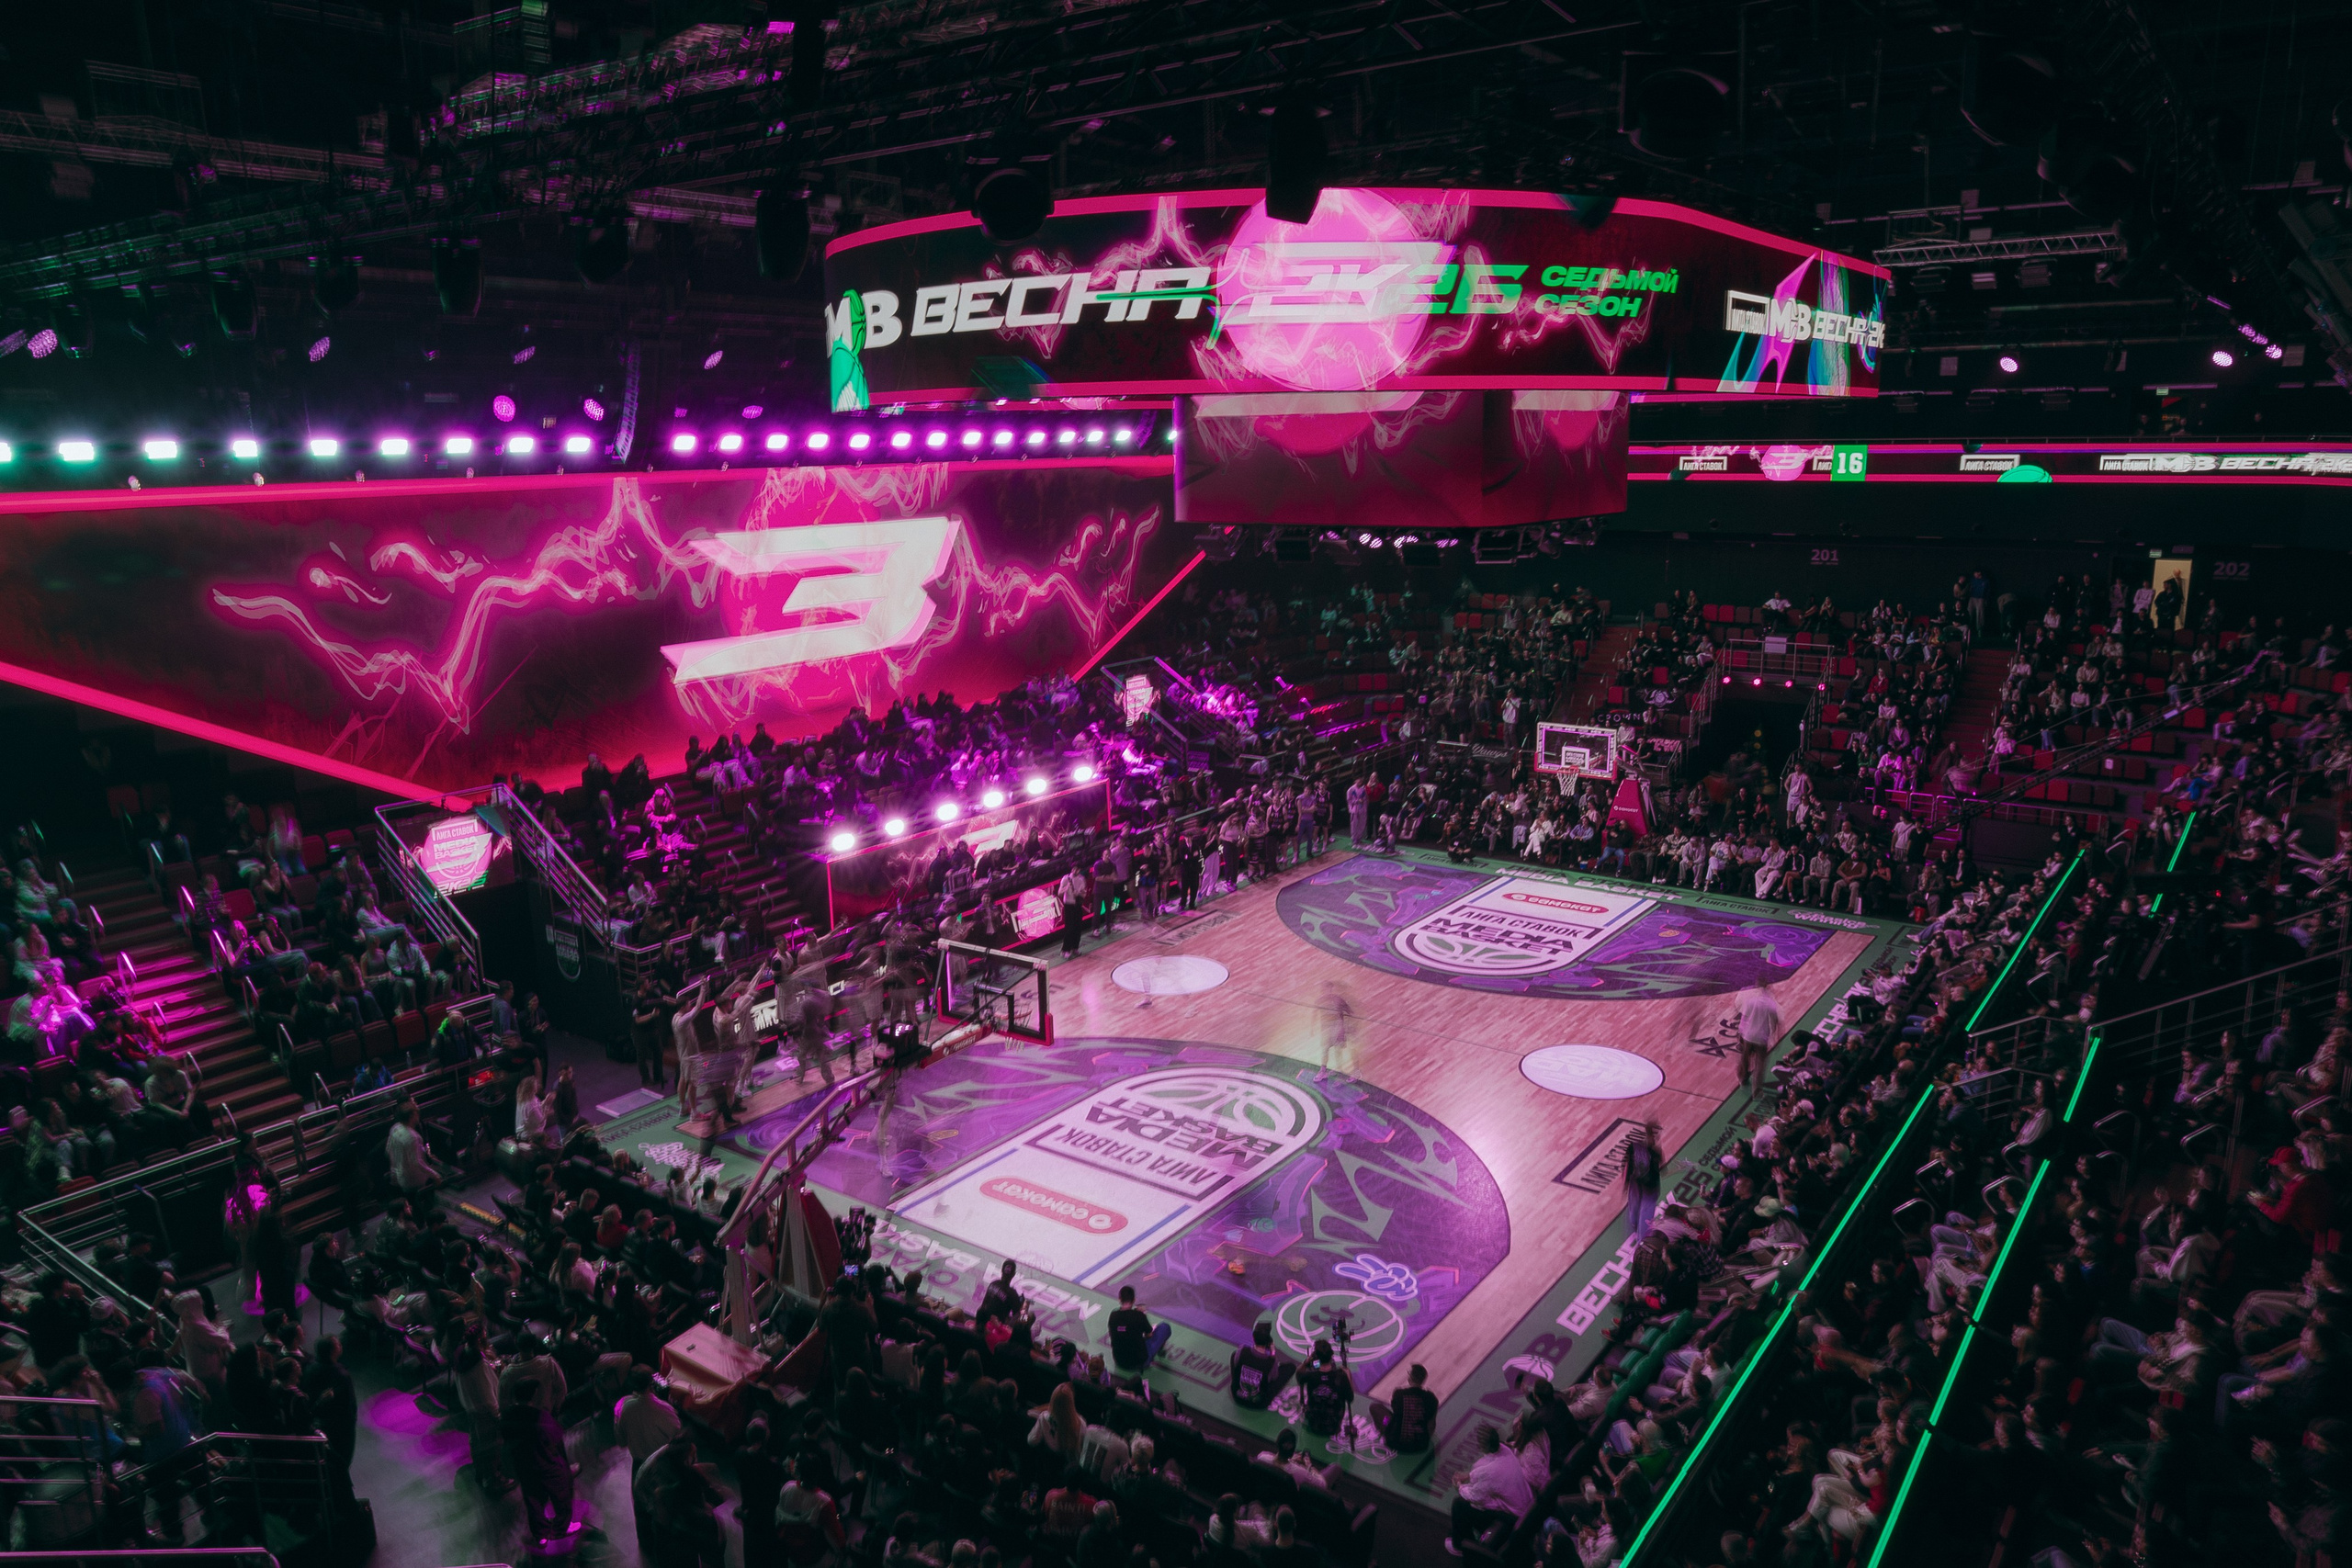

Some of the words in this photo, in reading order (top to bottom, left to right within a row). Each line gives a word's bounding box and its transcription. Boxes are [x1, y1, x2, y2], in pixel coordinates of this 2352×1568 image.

[1541, 265, 1679, 294] СЕДЬМОЙ
[910, 265, 1212, 337] ВЕСНА
[1534, 293, 1643, 318] СЕЗОН
[1700, 462, 1723, 470] СТАВОК
[1838, 453, 1864, 474] 16
[1811, 549, 1838, 561] 201
[2213, 561, 2250, 576] 202
[434, 836, 477, 852] MEDIA
[436, 829, 451, 840] ЛИГА
[451, 825, 474, 838] СТАВОК
[1496, 868, 1569, 885] MEDIA
[1574, 880, 1682, 901] BASKET
[1702, 899, 1728, 908] ЛИГА
[1728, 903, 1770, 914] СТАВОК
[1430, 918, 1574, 952] MEDIA
[1460, 910, 1504, 925] ЛИГА
[1507, 919, 1585, 939] СТАВОК
[1419, 924, 1563, 956] BASKET
[1085, 1101, 1267, 1171] MEDIA
[1106, 1097, 1283, 1155] BASKET
[1057, 1125, 1153, 1165] СТАВОК
[1148, 1155, 1218, 1185] ЛИГА
[1580, 1161, 1627, 1190] ЛИГА
[1555, 1231, 1639, 1336] ВЕСН
